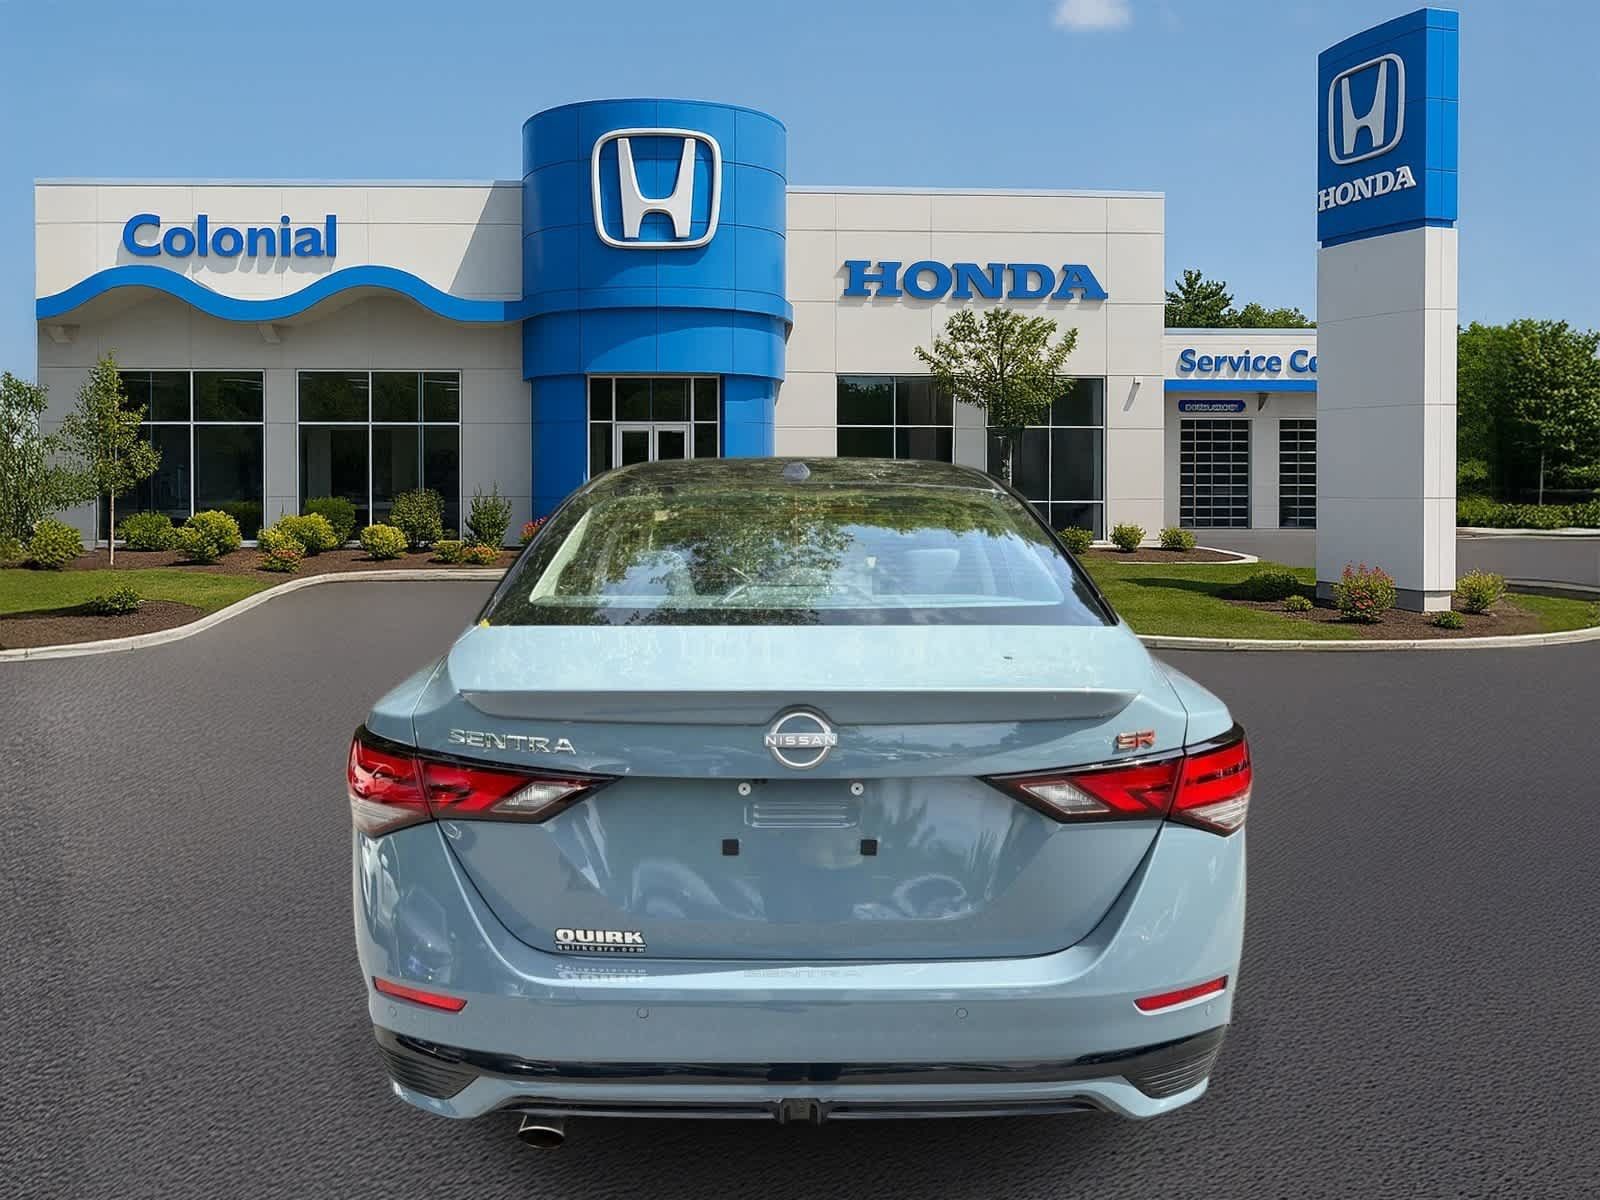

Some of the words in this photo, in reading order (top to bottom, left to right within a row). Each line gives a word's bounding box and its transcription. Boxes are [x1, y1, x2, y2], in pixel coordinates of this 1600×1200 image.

[1317, 165, 1416, 211] HONDA
[122, 213, 338, 258] Colonial
[843, 260, 1109, 300] HONDA
[1180, 349, 1282, 373] Service
[448, 728, 577, 755] SENTRA
[765, 735, 837, 746] NISSAN
[1115, 730, 1154, 750] SR
[555, 928, 644, 944] QUIRK
